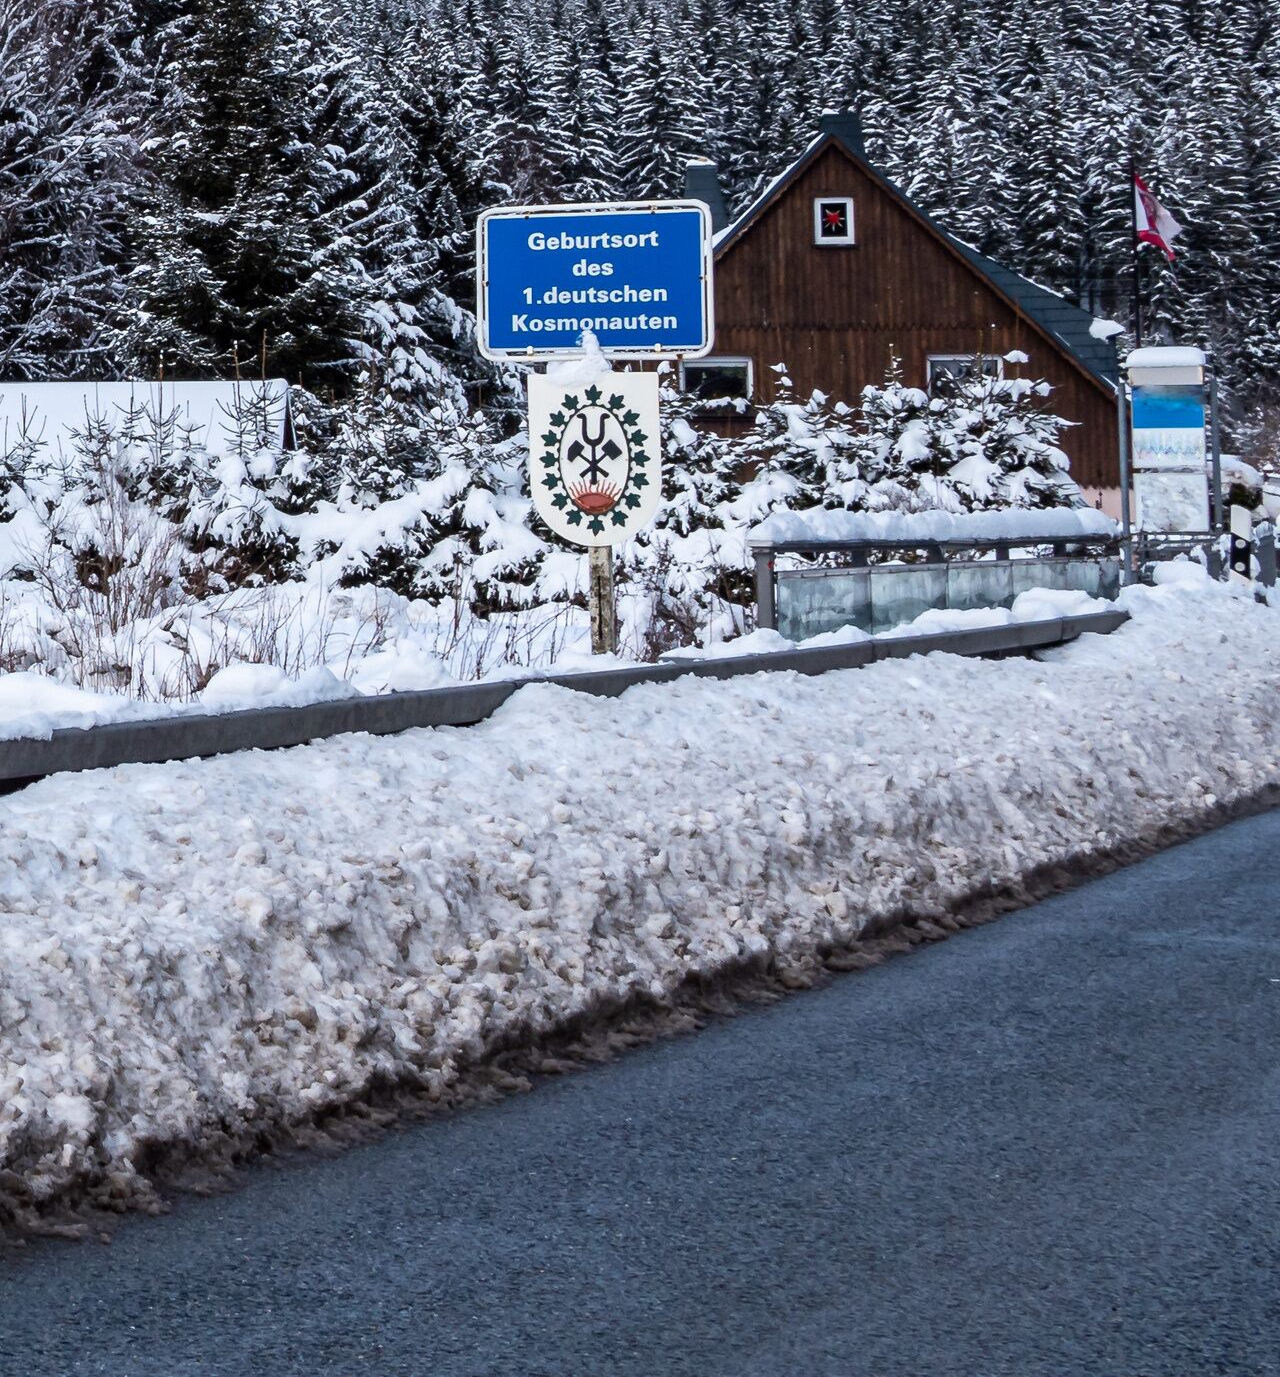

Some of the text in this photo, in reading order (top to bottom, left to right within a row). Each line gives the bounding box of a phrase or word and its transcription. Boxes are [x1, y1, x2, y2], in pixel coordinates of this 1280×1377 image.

[527, 231, 659, 250] Geburtsort
[572, 259, 614, 276] des
[523, 285, 667, 304] 1.deutschen
[512, 314, 677, 331] Kosmonauten
